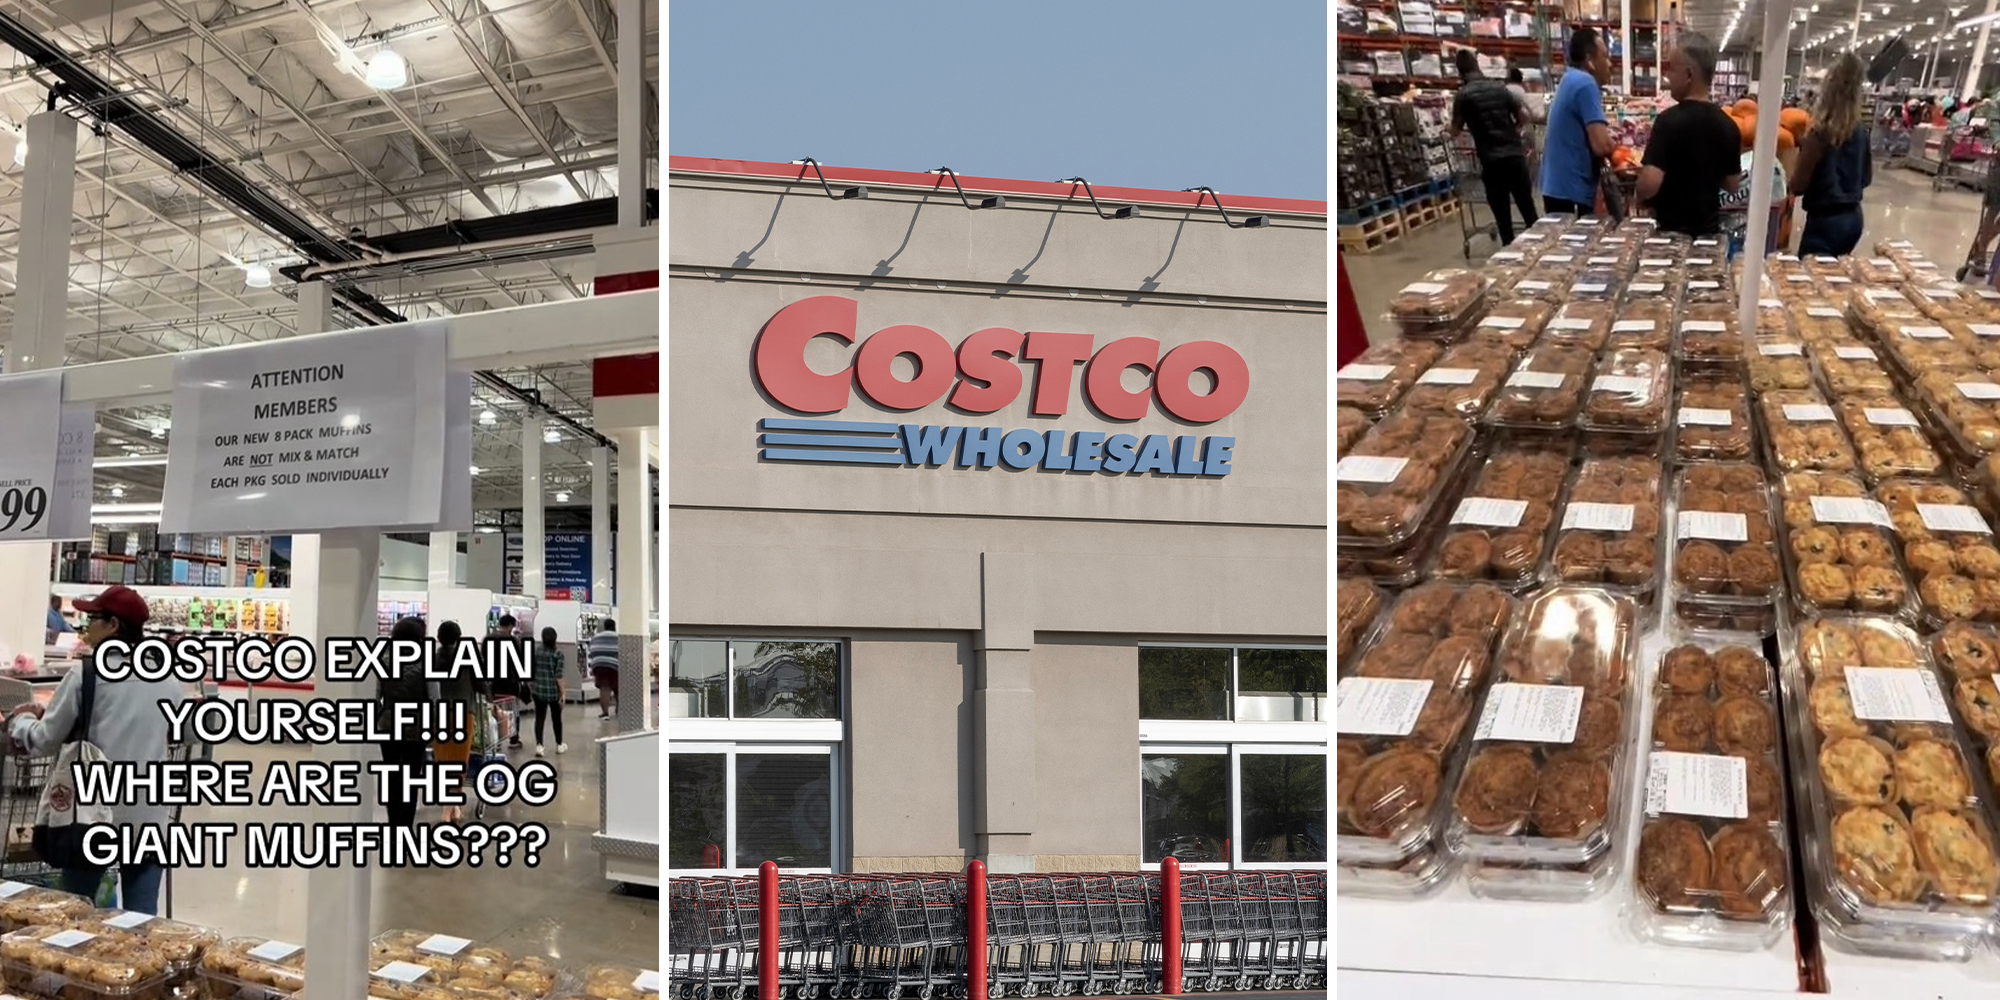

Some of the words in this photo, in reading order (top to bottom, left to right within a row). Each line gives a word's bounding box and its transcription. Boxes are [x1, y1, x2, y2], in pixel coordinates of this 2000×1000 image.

[753, 295, 1250, 423] COSTCO
[250, 363, 344, 390] ATTENTION
[253, 396, 338, 420] MEMBERS
[214, 435, 239, 447] OUR
[243, 431, 270, 445] NEW
[274, 431, 281, 442] 8
[284, 428, 314, 441] PACK
[318, 423, 372, 439] MUFFINS
[223, 455, 245, 468] ARE
[249, 453, 273, 467] NOT
[278, 450, 301, 464] MIX
[303, 449, 313, 461] &
[316, 447, 360, 461] MATCH
[899, 424, 1237, 477] WHOLESALE
[14, 478, 32, 487] PRICE
[210, 477, 239, 489] EACH
[244, 475, 266, 487] PKG
[271, 472, 300, 486] SOLD
[306, 466, 389, 484] INDIVIDUALLY
[555, 535, 585, 543] ONLINE
